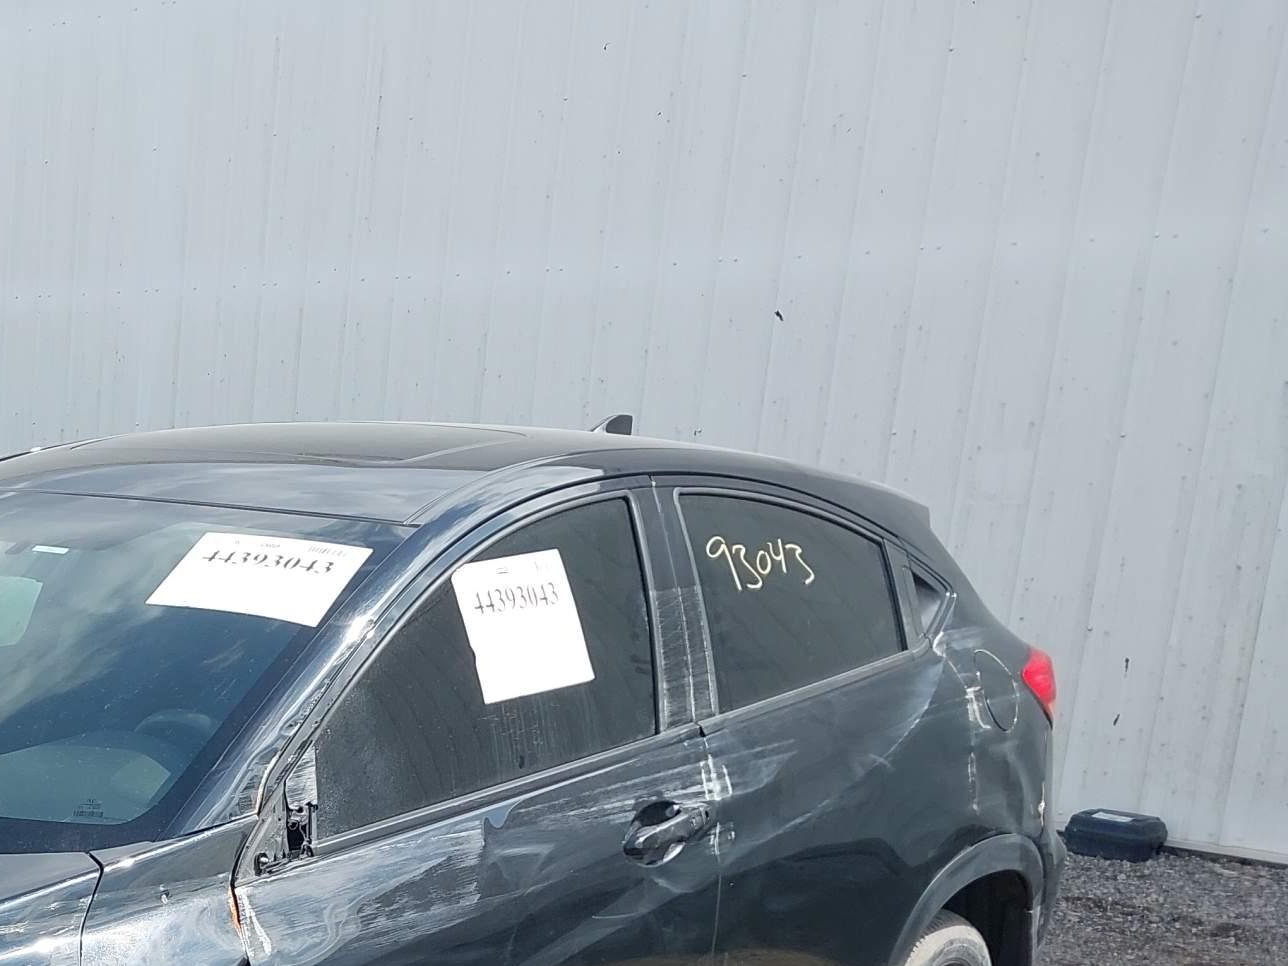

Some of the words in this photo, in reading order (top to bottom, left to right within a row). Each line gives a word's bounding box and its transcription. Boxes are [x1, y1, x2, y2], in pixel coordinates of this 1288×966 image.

[202, 549, 335, 575] 44393043
[705, 535, 816, 592] 93043
[473, 581, 560, 615] 44393043
